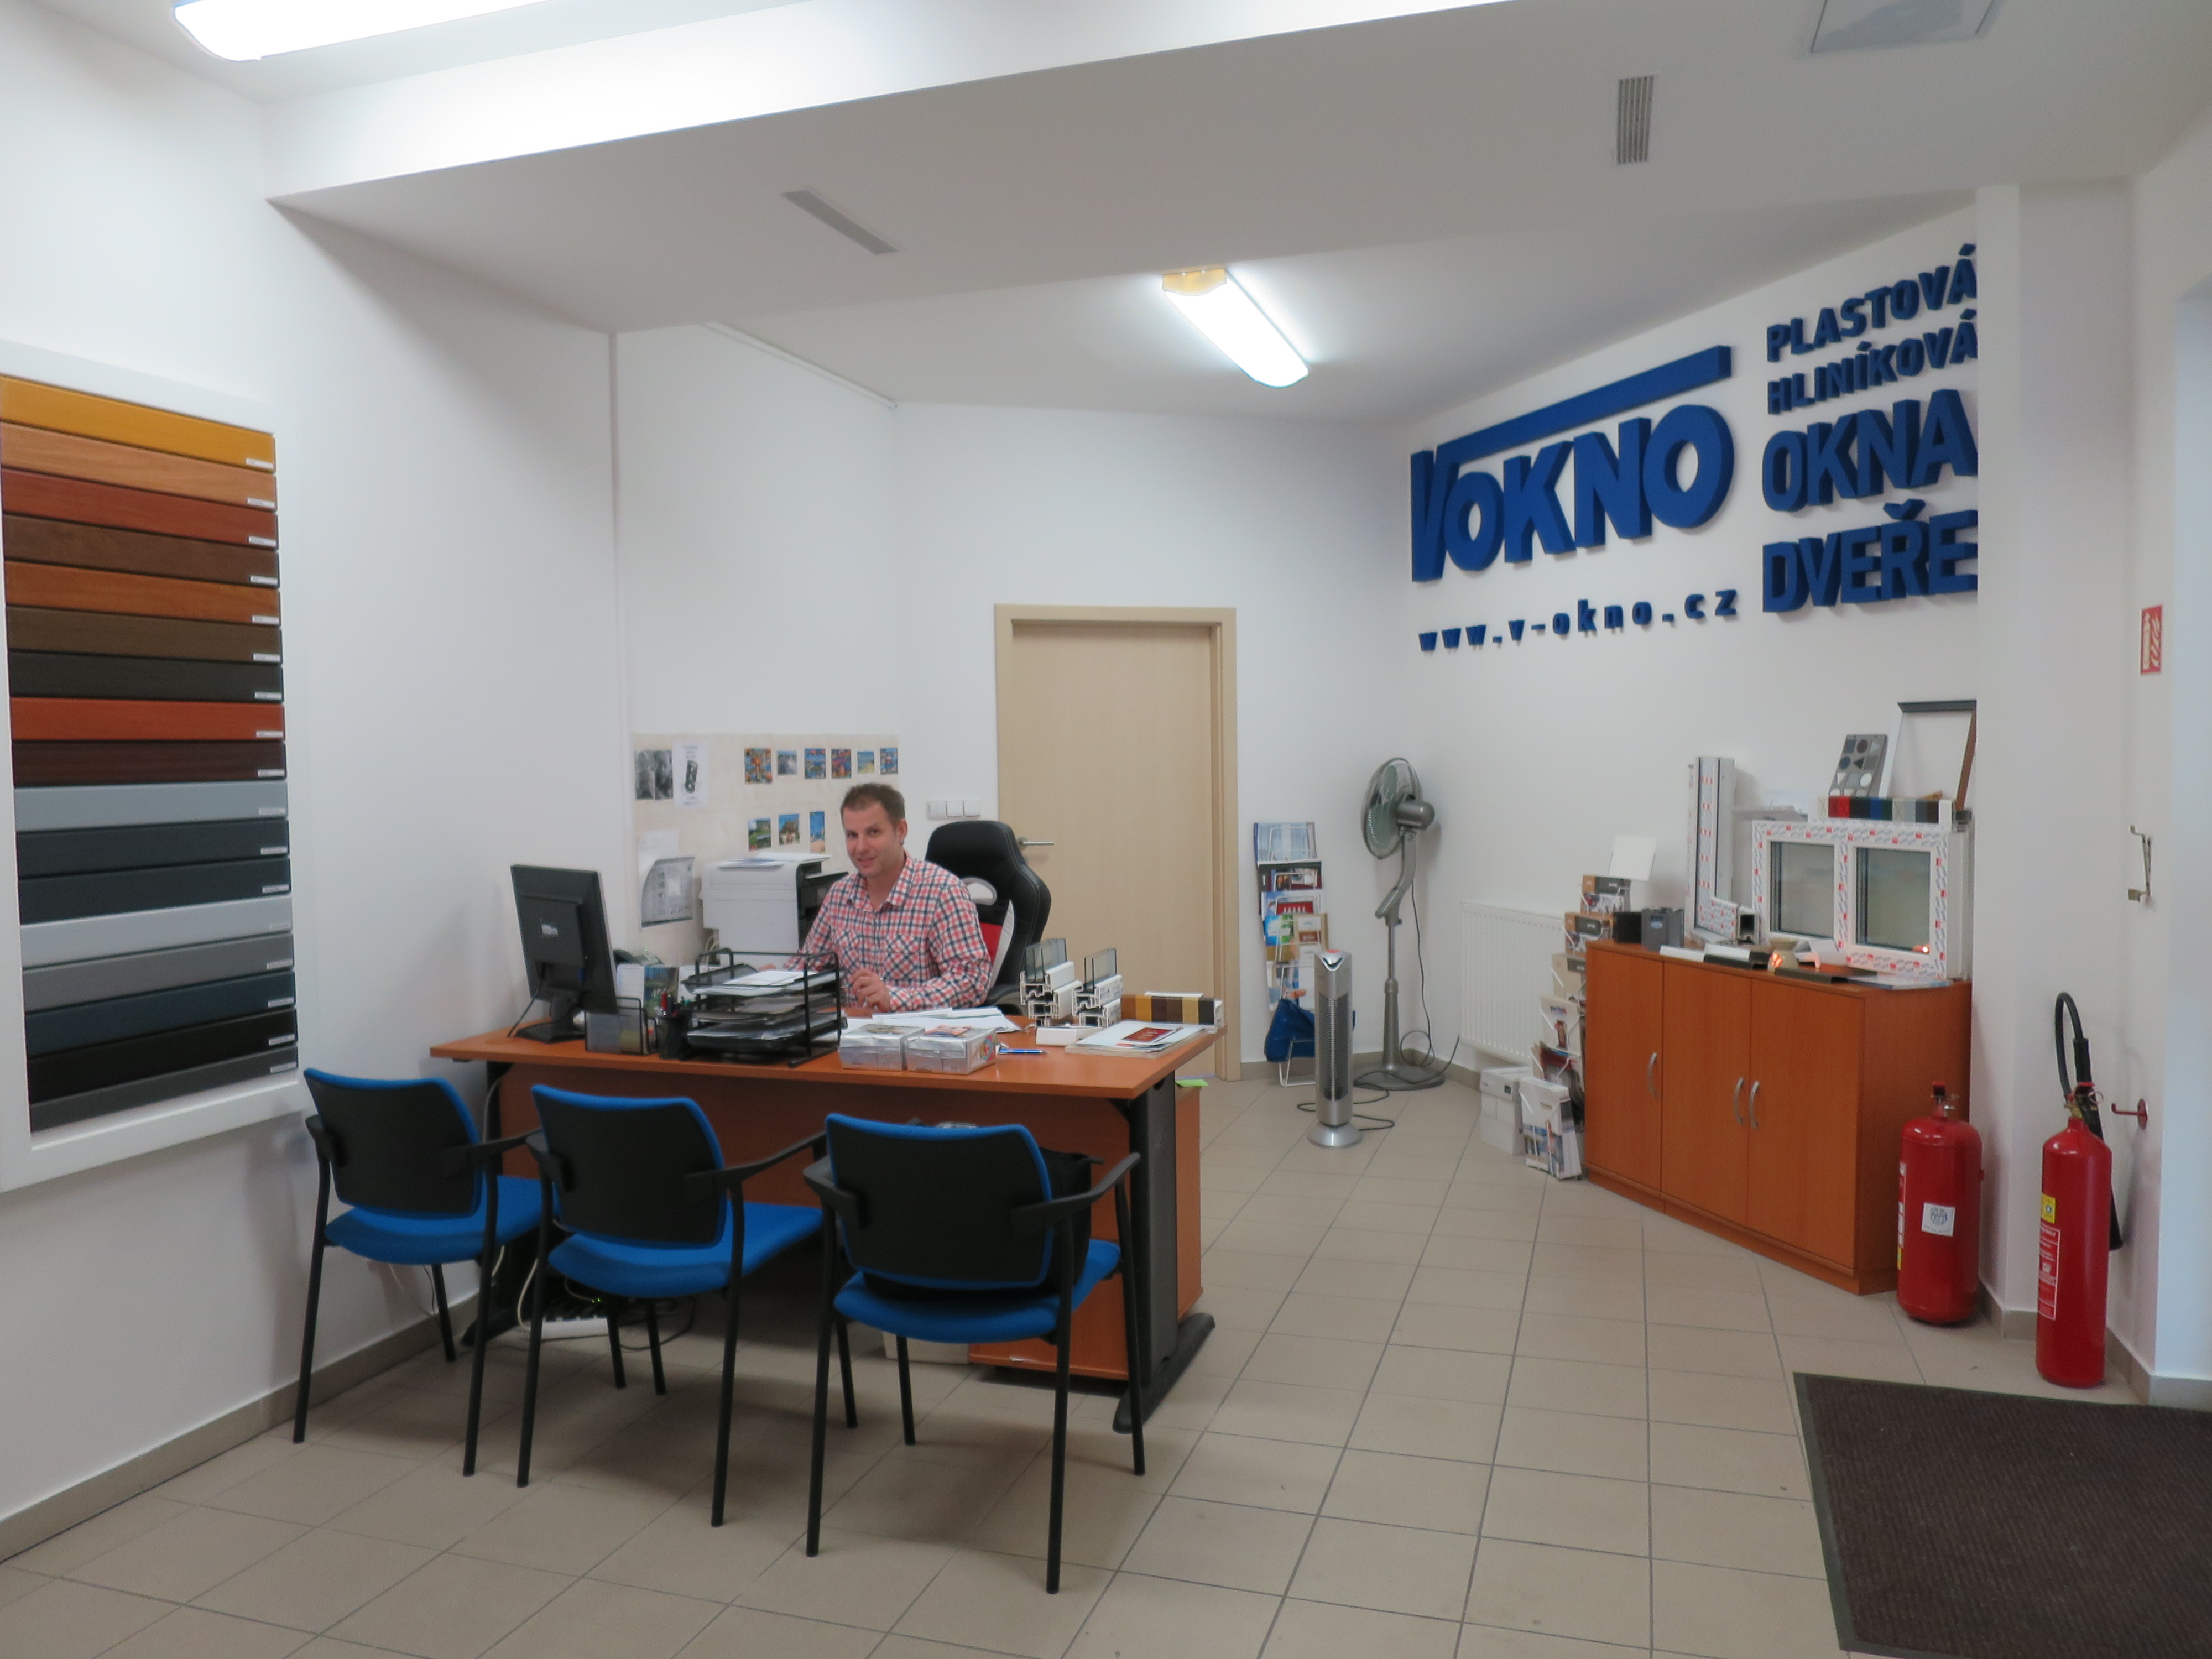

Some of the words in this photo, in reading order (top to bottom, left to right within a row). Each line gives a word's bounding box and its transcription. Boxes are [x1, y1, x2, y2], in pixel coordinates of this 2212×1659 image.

[1767, 243, 1978, 362] PLASTOVÁ
[1767, 309, 1978, 414] HLINÍKOVÁ
[1762, 389, 1978, 512] OKNA
[1762, 499, 1978, 613] DVEŘE
[1419, 589, 1737, 651] www.v-okno.cz
